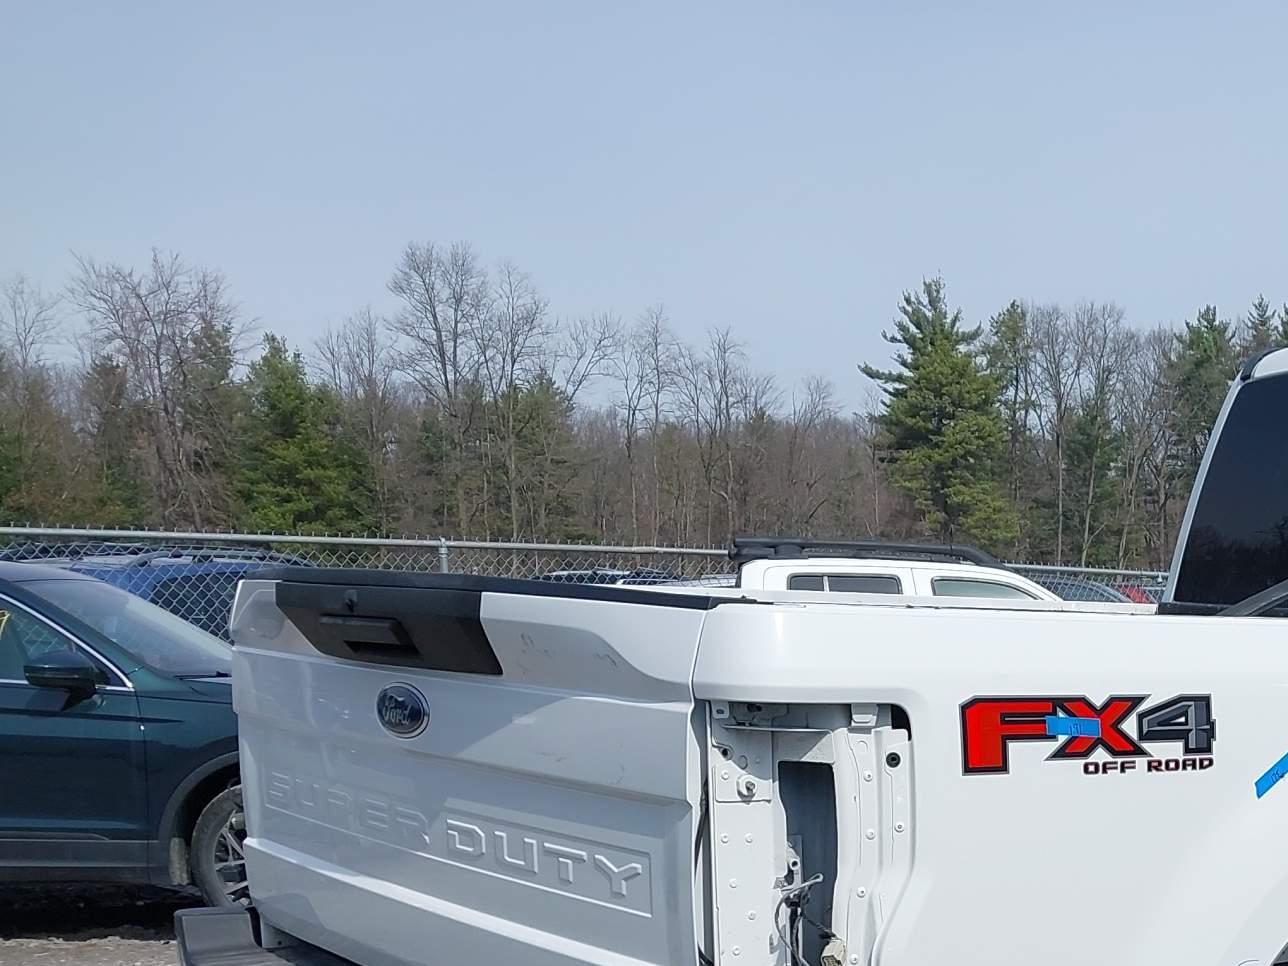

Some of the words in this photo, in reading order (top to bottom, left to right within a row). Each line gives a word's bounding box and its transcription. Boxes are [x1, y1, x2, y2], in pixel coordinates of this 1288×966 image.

[382, 694, 411, 725] Ford
[959, 694, 1216, 776] FX4
[1083, 759, 1137, 775] OFF
[1147, 757, 1214, 773] ROAD
[267, 771, 431, 847] SUPER
[445, 817, 643, 899] DUTY
